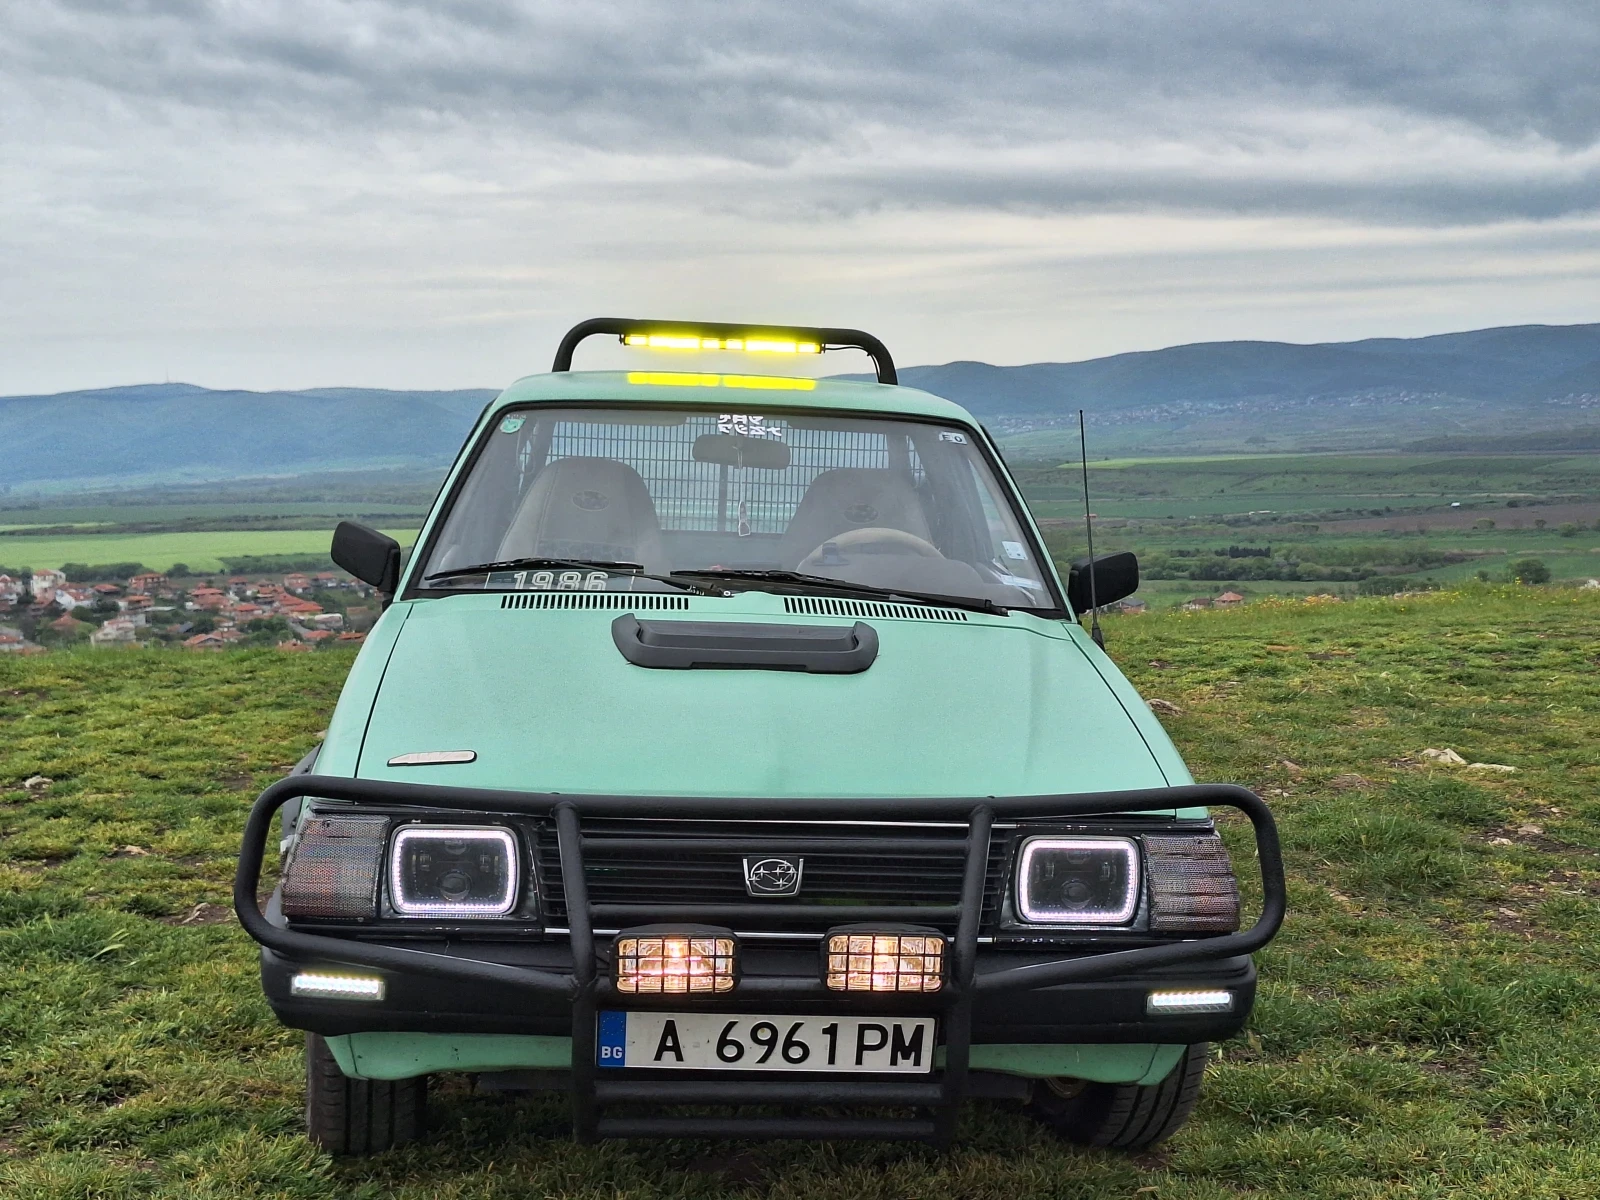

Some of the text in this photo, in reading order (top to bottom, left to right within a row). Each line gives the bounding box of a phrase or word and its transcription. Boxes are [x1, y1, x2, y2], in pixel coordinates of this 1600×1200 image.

[514, 571, 609, 590] 1986
[653, 1019, 684, 1062] A
[601, 1046, 623, 1059] BG
